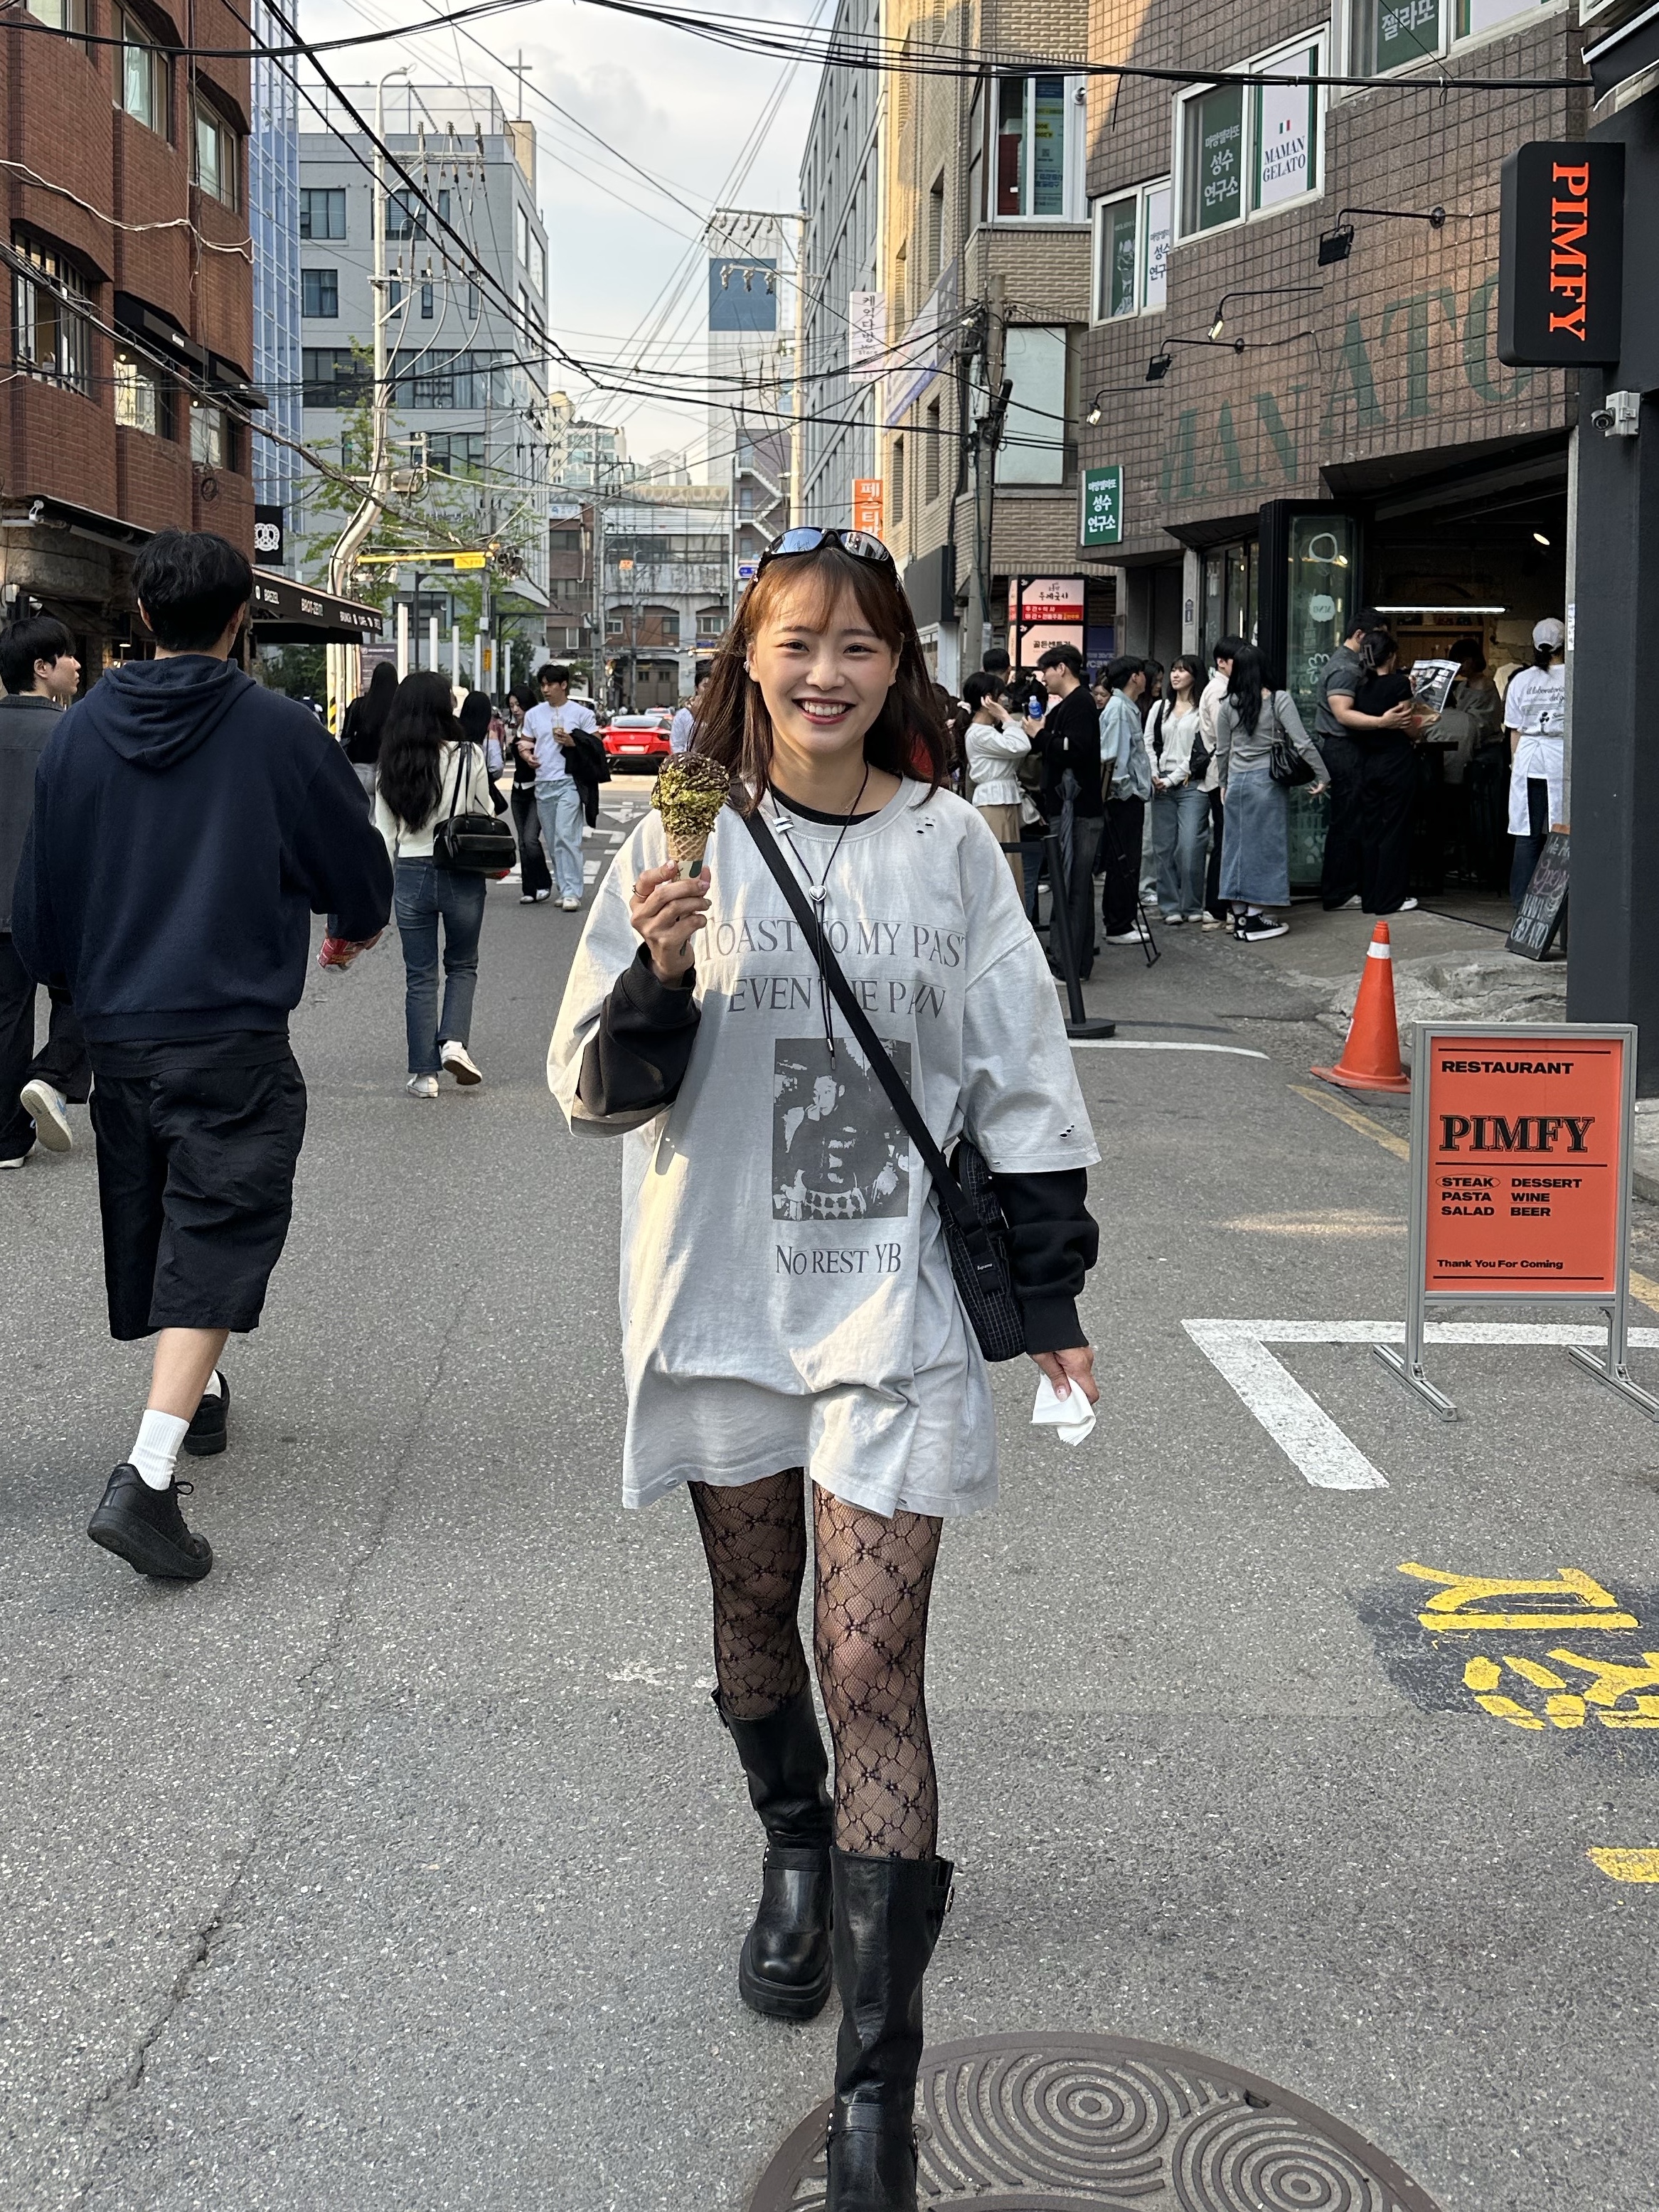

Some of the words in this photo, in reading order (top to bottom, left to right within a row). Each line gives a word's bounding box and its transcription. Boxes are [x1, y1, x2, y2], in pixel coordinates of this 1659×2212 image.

[1210, 149, 1234, 176] 성수
[1264, 135, 1305, 165] MAMAN
[1263, 154, 1306, 183] GELATO
[1204, 176, 1239, 207] 연구소
[1549, 161, 1590, 341] PIMFY
[862, 295, 876, 343] 케익다방
[1092, 494, 1112, 512] 성수
[1087, 514, 1116, 533] 연구소
[704, 917, 799, 961] TOAST
[857, 921, 902, 956] MY
[913, 925, 966, 968] PAS
[727, 977, 812, 1013] EVEN
[1441, 1060, 1574, 1075] RESTAURANT
[1439, 1114, 1595, 1153] PIMFY
[1441, 1177, 1494, 1188] STEAK
[1511, 1177, 1582, 1189] DESSERT
[1441, 1191, 1492, 1202] PASTA
[1511, 1192, 1551, 1203] WINE
[1441, 1206, 1495, 1217] SALAD
[1510, 1206, 1551, 1217] BEER
[812, 1250, 869, 1273] REST
[875, 1243, 902, 1273] YB
[1437, 1259, 1472, 1268] Thank
[1474, 1259, 1496, 1268] You
[1498, 1259, 1518, 1268] For
[1520, 1259, 1564, 1271] Coming
